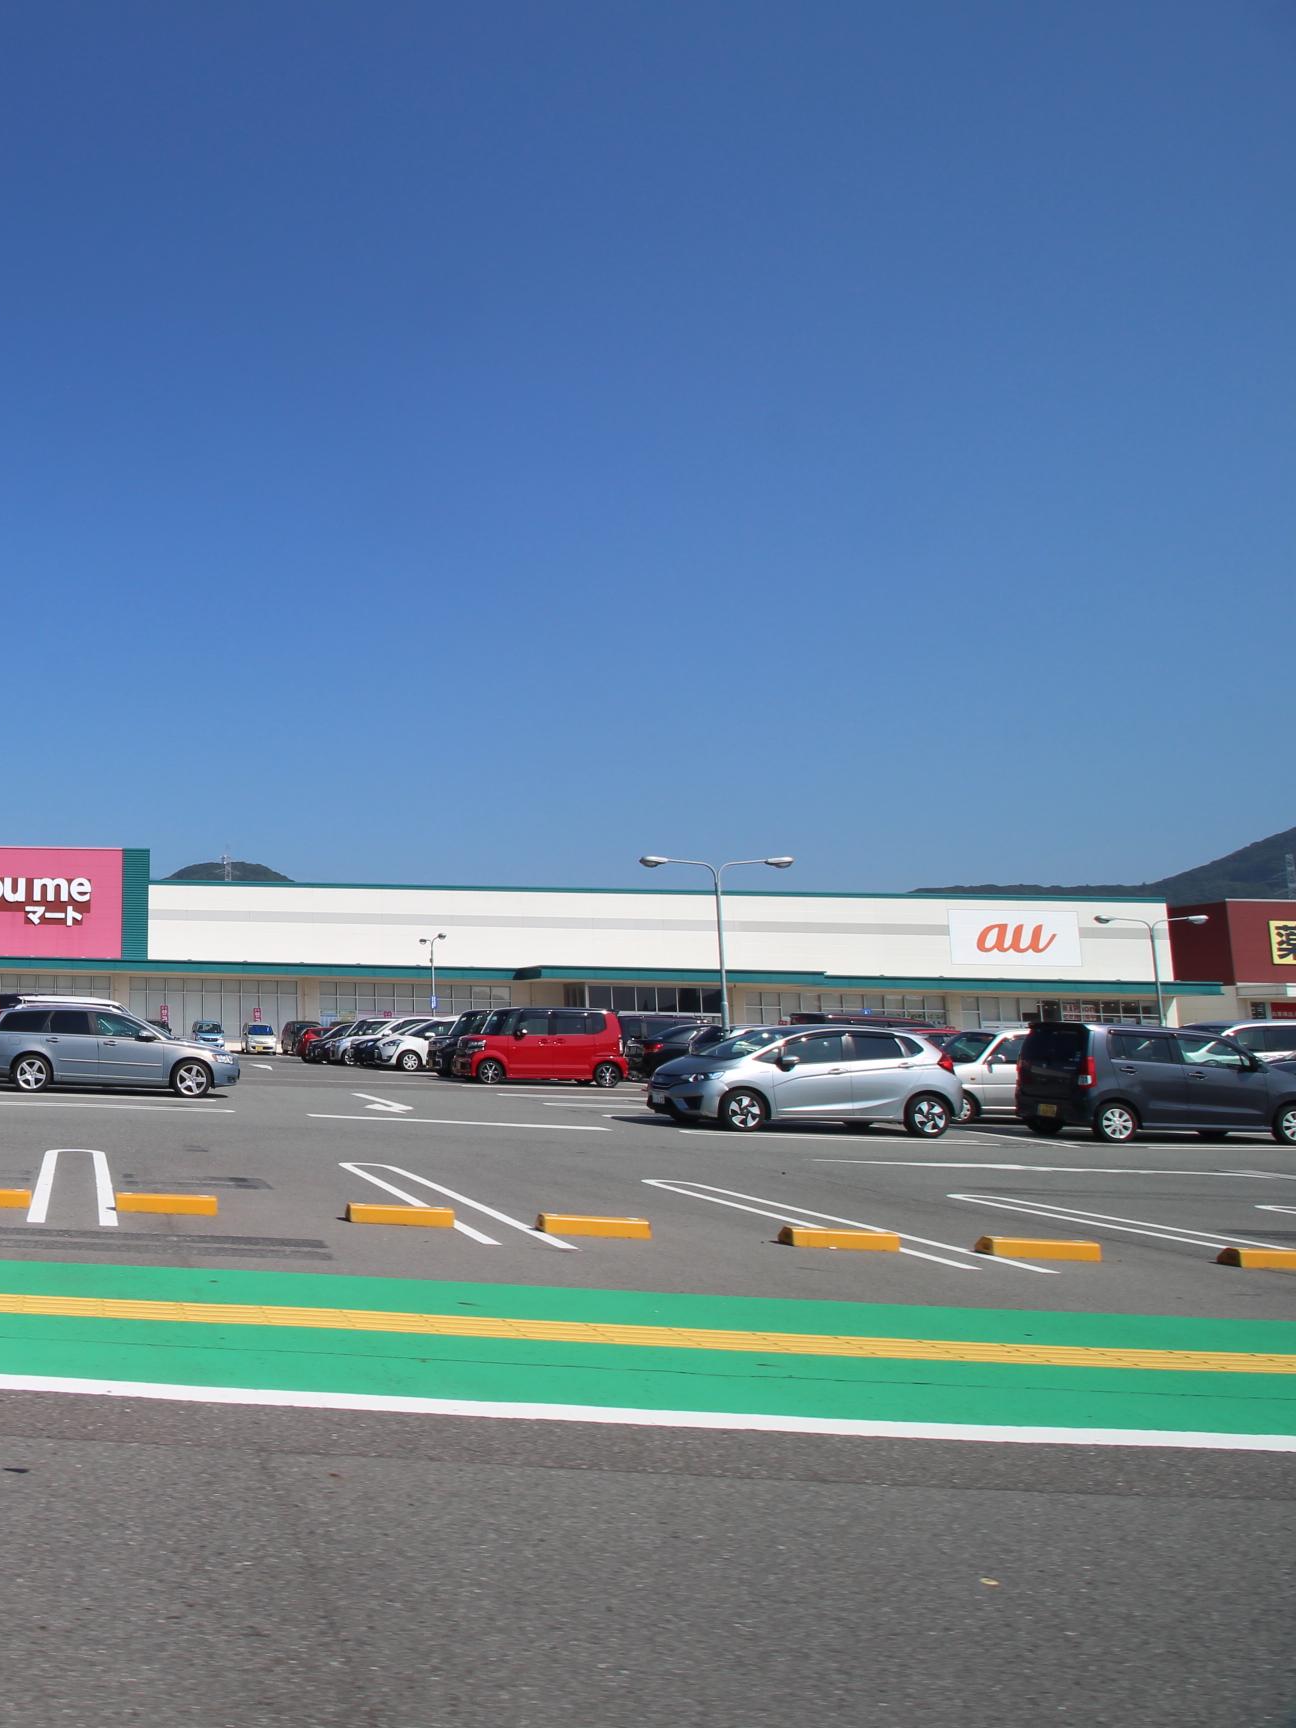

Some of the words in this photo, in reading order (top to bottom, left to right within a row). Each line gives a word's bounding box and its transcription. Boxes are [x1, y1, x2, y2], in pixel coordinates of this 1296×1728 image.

[24, 905, 82, 926] マート
[976, 923, 1057, 953] au
